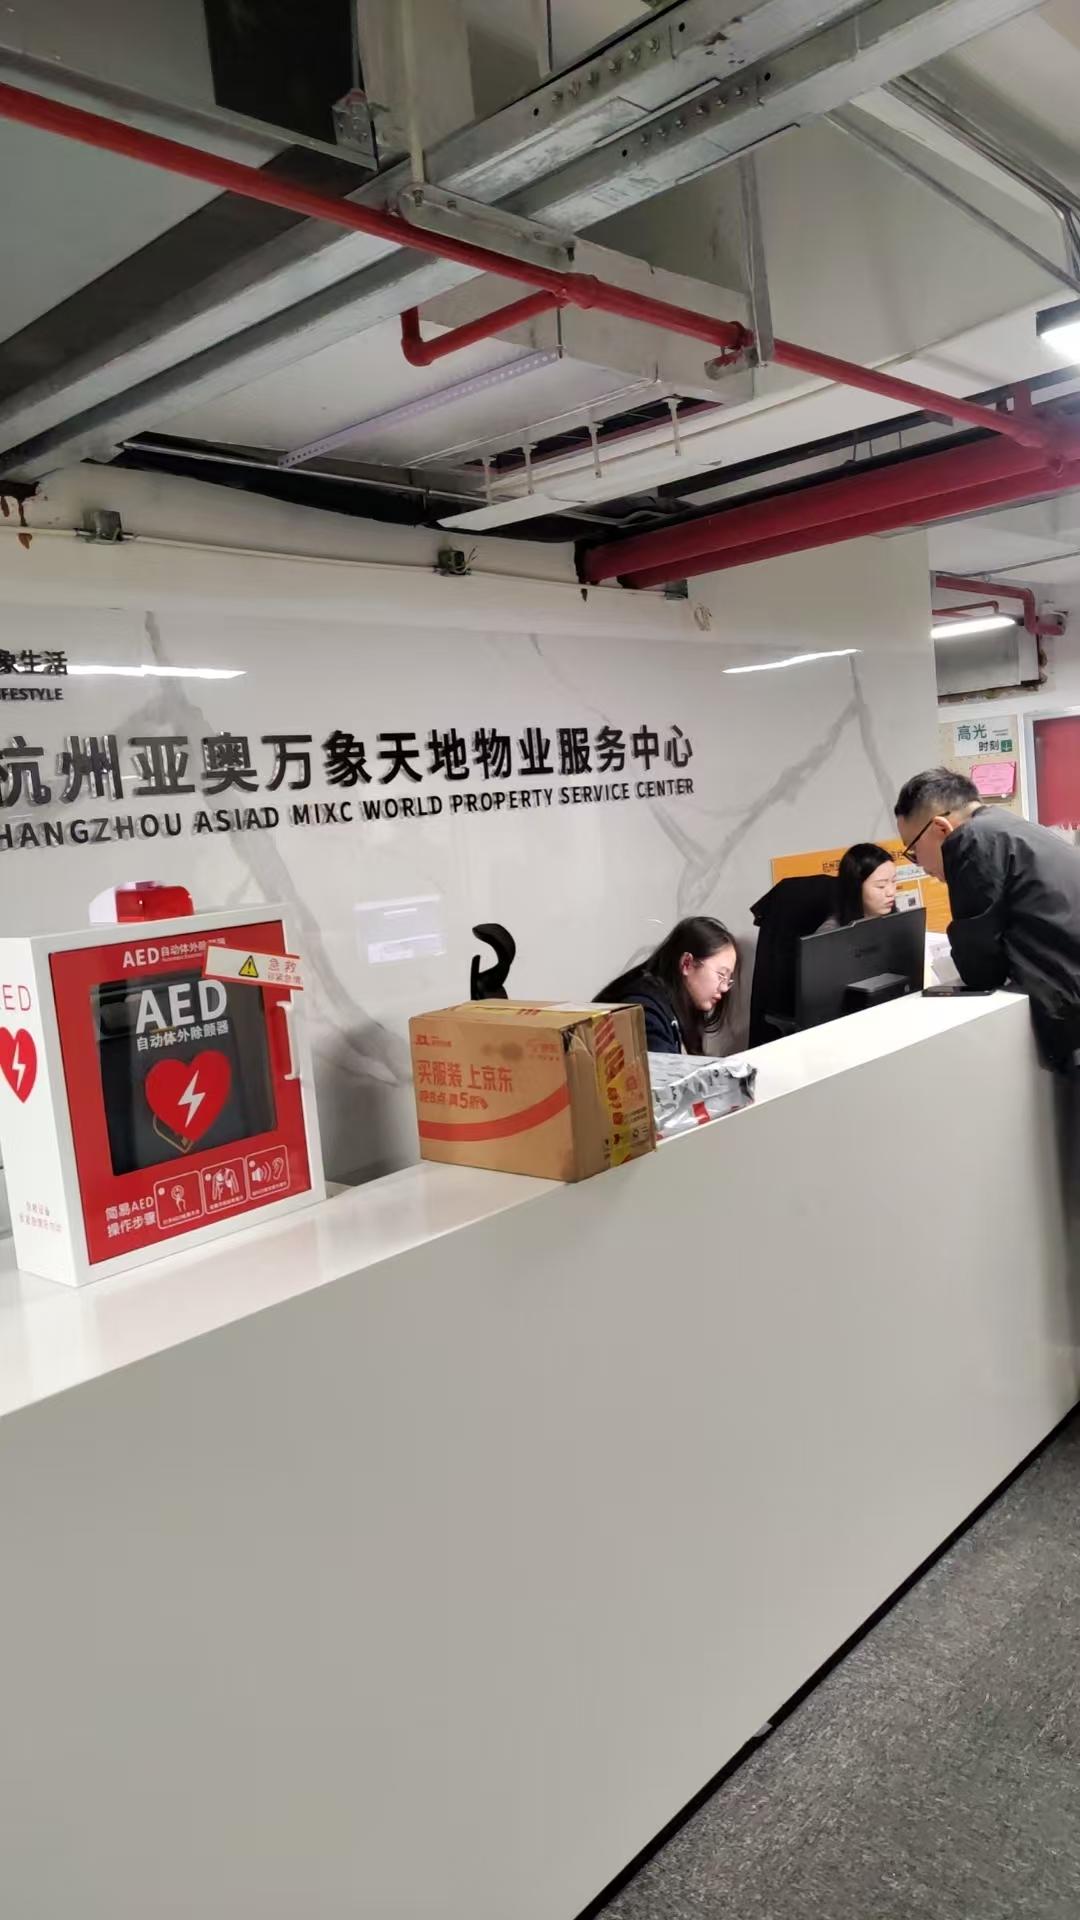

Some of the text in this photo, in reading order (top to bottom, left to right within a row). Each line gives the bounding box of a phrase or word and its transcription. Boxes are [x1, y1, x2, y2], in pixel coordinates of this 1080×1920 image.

[0, 649, 68, 676] 象生活
[0, 687, 64, 701] FESTYLE
[957, 723, 988, 741] 高光
[978, 740, 1000, 752] 时刻
[0, 724, 694, 807] 杭州亚奥万象天地物业服务中心
[0, 778, 695, 849] HANGZHOU ASIAD MIXC WORLD PROPERTY SERVICE CENTER
[122, 946, 160, 968] AED
[0, 984, 32, 1011] ED
[136, 979, 228, 1034] AED
[136, 1019, 230, 1051] 自动体外除颤器
[417, 1060, 513, 1093] 买服装 上京东
[107, 1211, 157, 1238] 操作步骤
